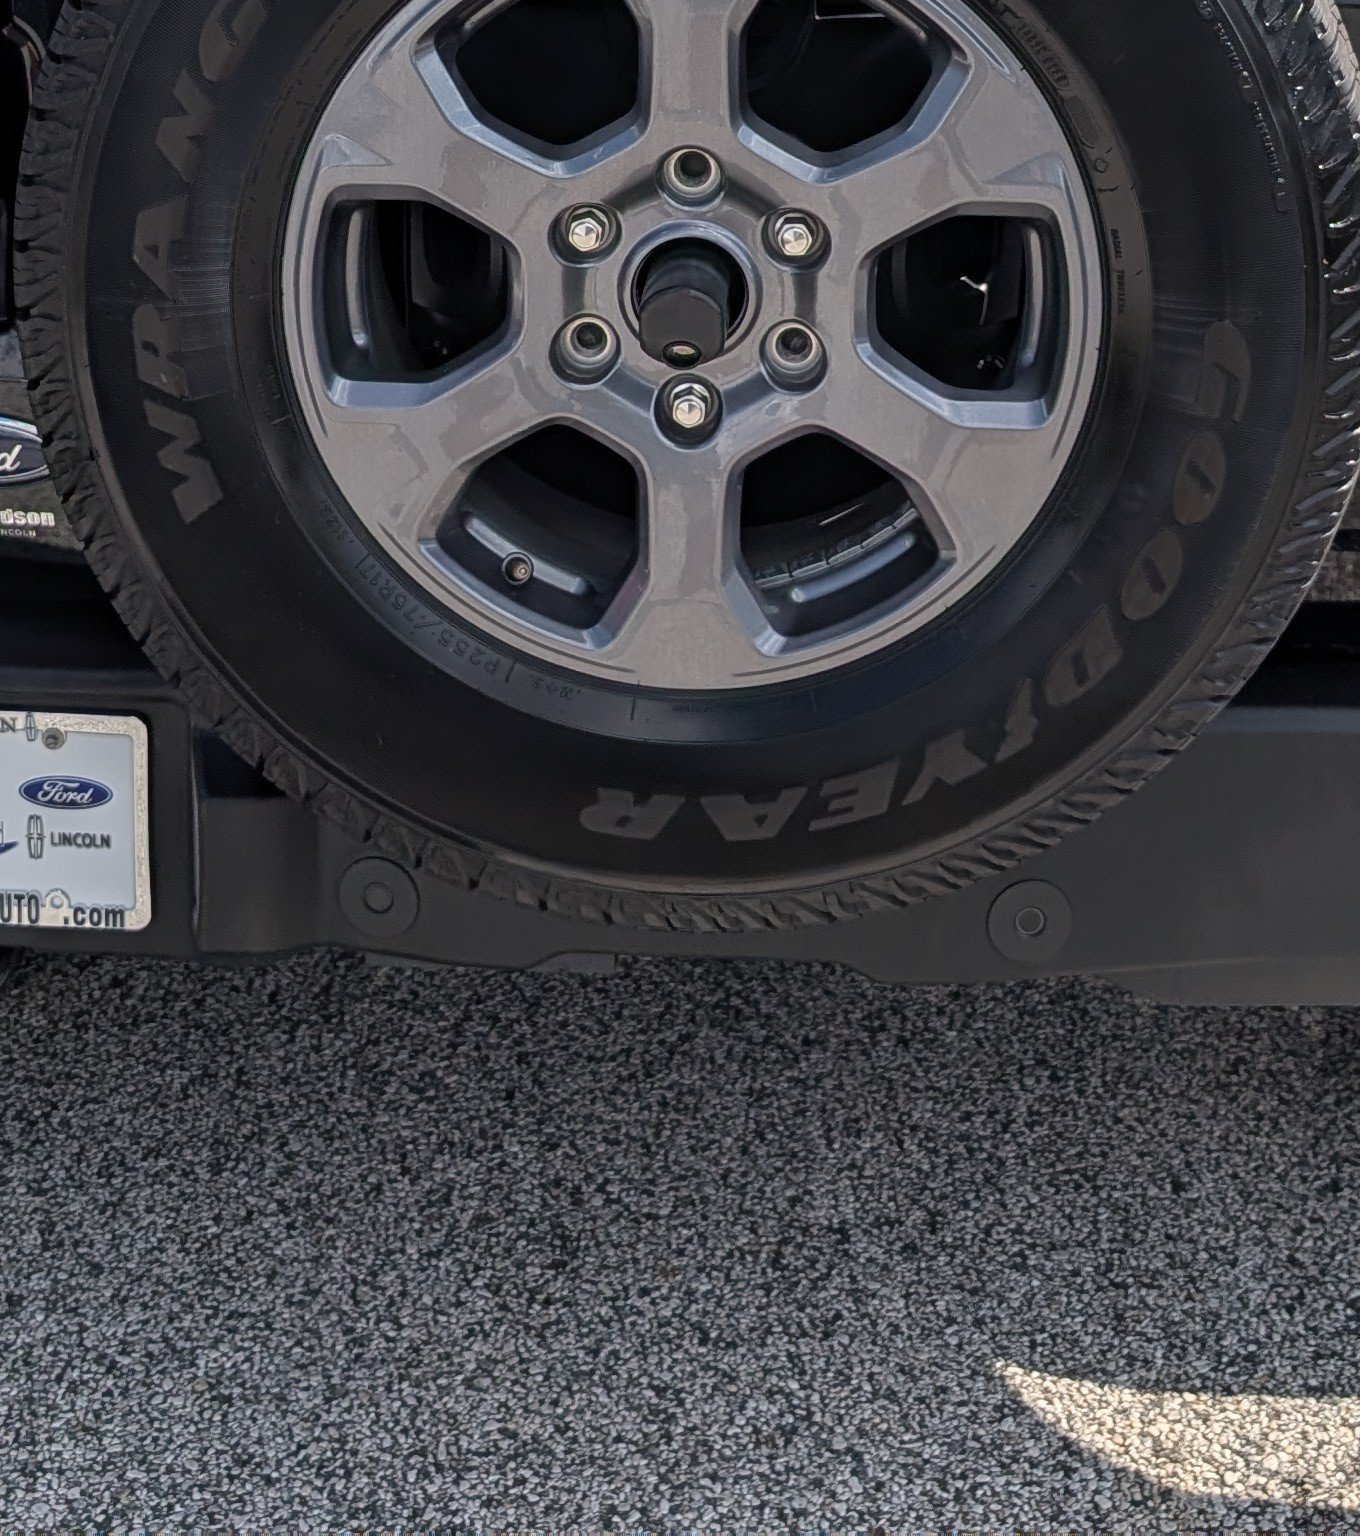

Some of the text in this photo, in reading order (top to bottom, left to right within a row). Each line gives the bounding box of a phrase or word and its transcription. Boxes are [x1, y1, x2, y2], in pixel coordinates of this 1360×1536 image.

[579, 320, 1253, 843] GOODYEAR
[36, 780, 95, 806] Ford
[50, 831, 111, 850] LINCOLN
[63, 904, 126, 928] .com
